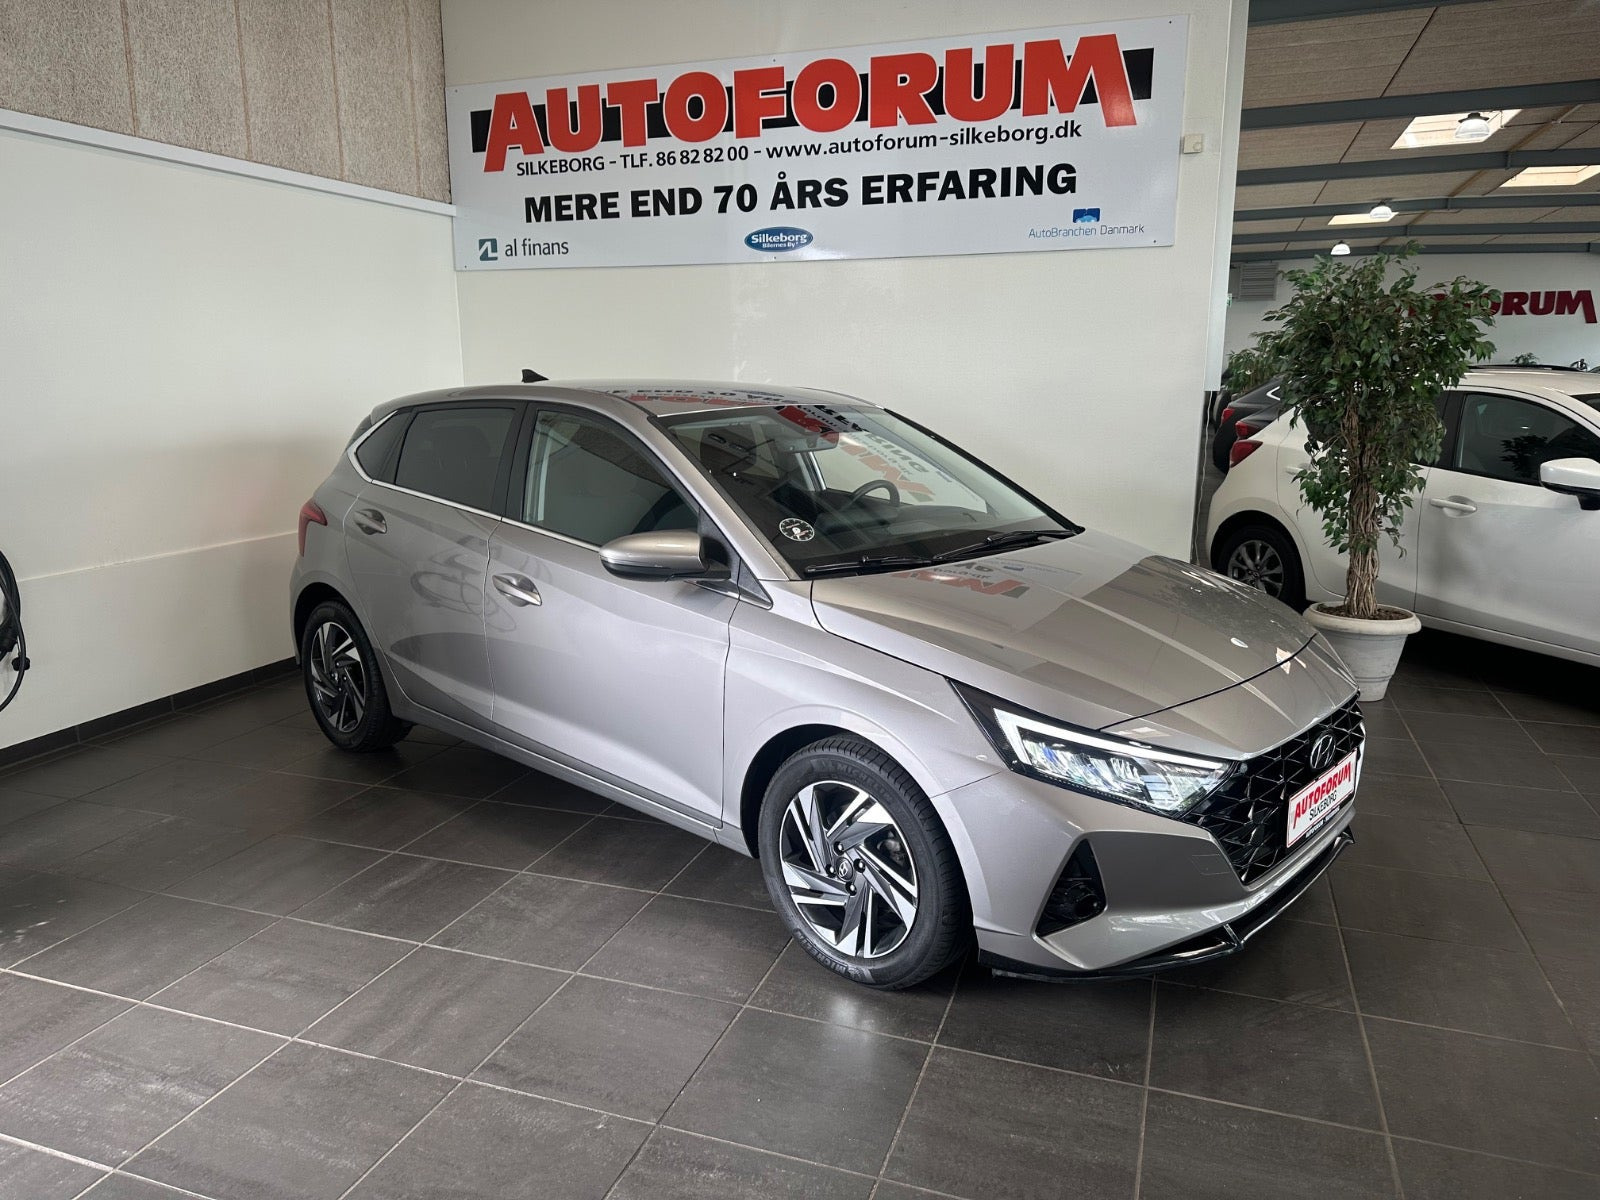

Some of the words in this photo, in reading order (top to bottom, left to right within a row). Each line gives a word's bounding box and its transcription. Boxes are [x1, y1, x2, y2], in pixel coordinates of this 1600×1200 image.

[484, 33, 1137, 172] AUTOFORUM
[516, 156, 605, 176] SILKEBORG
[620, 152, 653, 169] TLF.
[766, 120, 1082, 159] www.autoforum-silkeborg.dk
[525, 191, 621, 223] MERE
[631, 188, 703, 217] END
[713, 184, 758, 214] 70
[770, 171, 849, 211] ÅRS
[861, 163, 1077, 205] ERFARING
[504, 237, 518, 257] al
[521, 237, 570, 257] finans
[751, 232, 807, 244] Silkeborg
[1028, 226, 1097, 239] AutoBranchen
[1100, 223, 1145, 236] Danmark
[1292, 761, 1352, 830] AUTOFORUM
[1309, 790, 1338, 821] SILKEBORG
